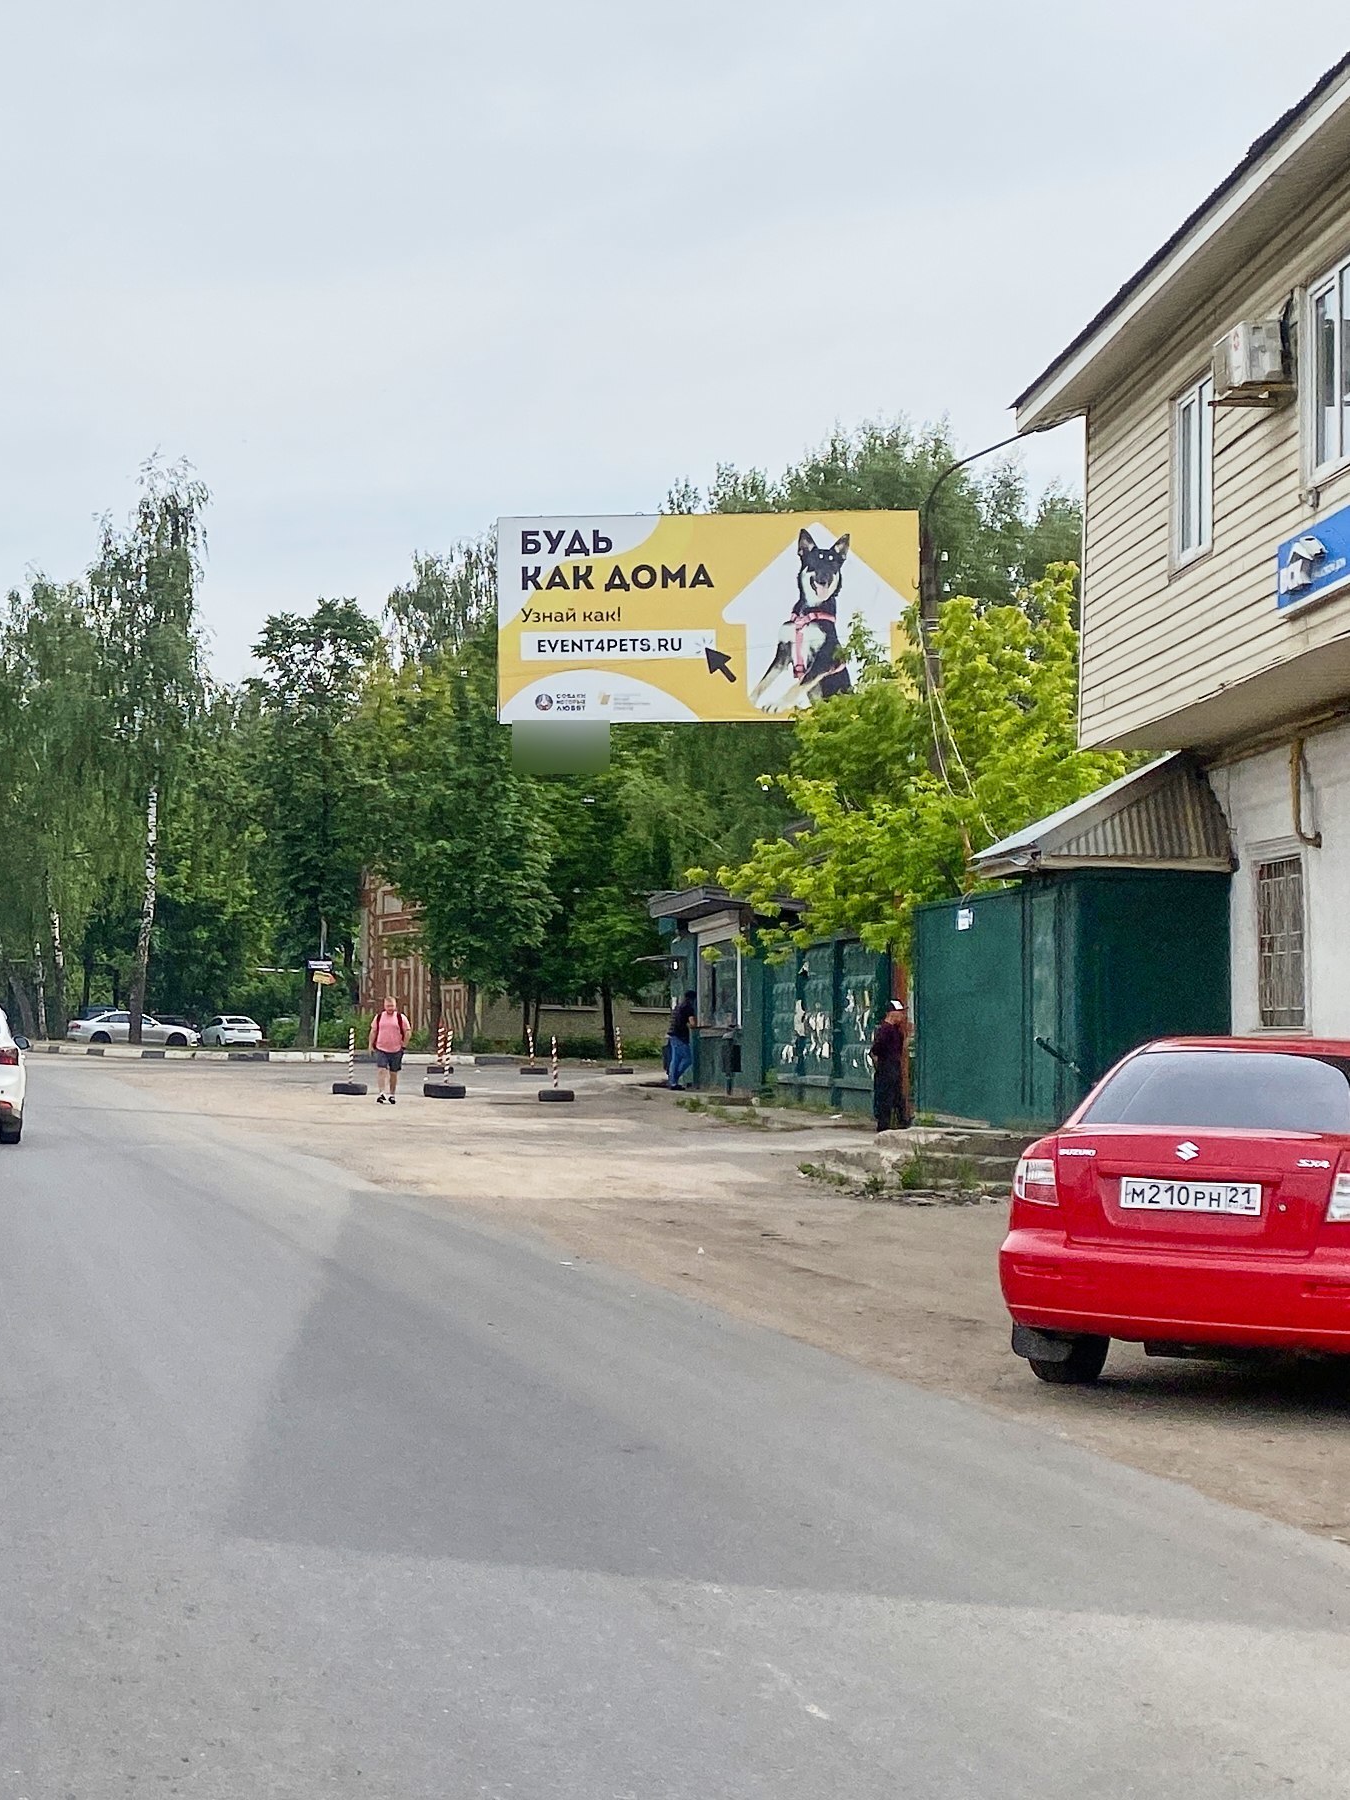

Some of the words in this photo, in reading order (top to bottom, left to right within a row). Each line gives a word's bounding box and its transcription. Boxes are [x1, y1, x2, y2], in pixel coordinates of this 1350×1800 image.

[521, 529, 613, 557] БУДЬ
[521, 564, 595, 591] КАК
[604, 563, 715, 592] ДОМА
[521, 607, 577, 623] Узнай
[582, 606, 621, 622] как!
[537, 638, 682, 653] EVENT4PETS.RU
[1131, 1184, 1222, 1208] М210РН
[1228, 1187, 1251, 1204] 21
